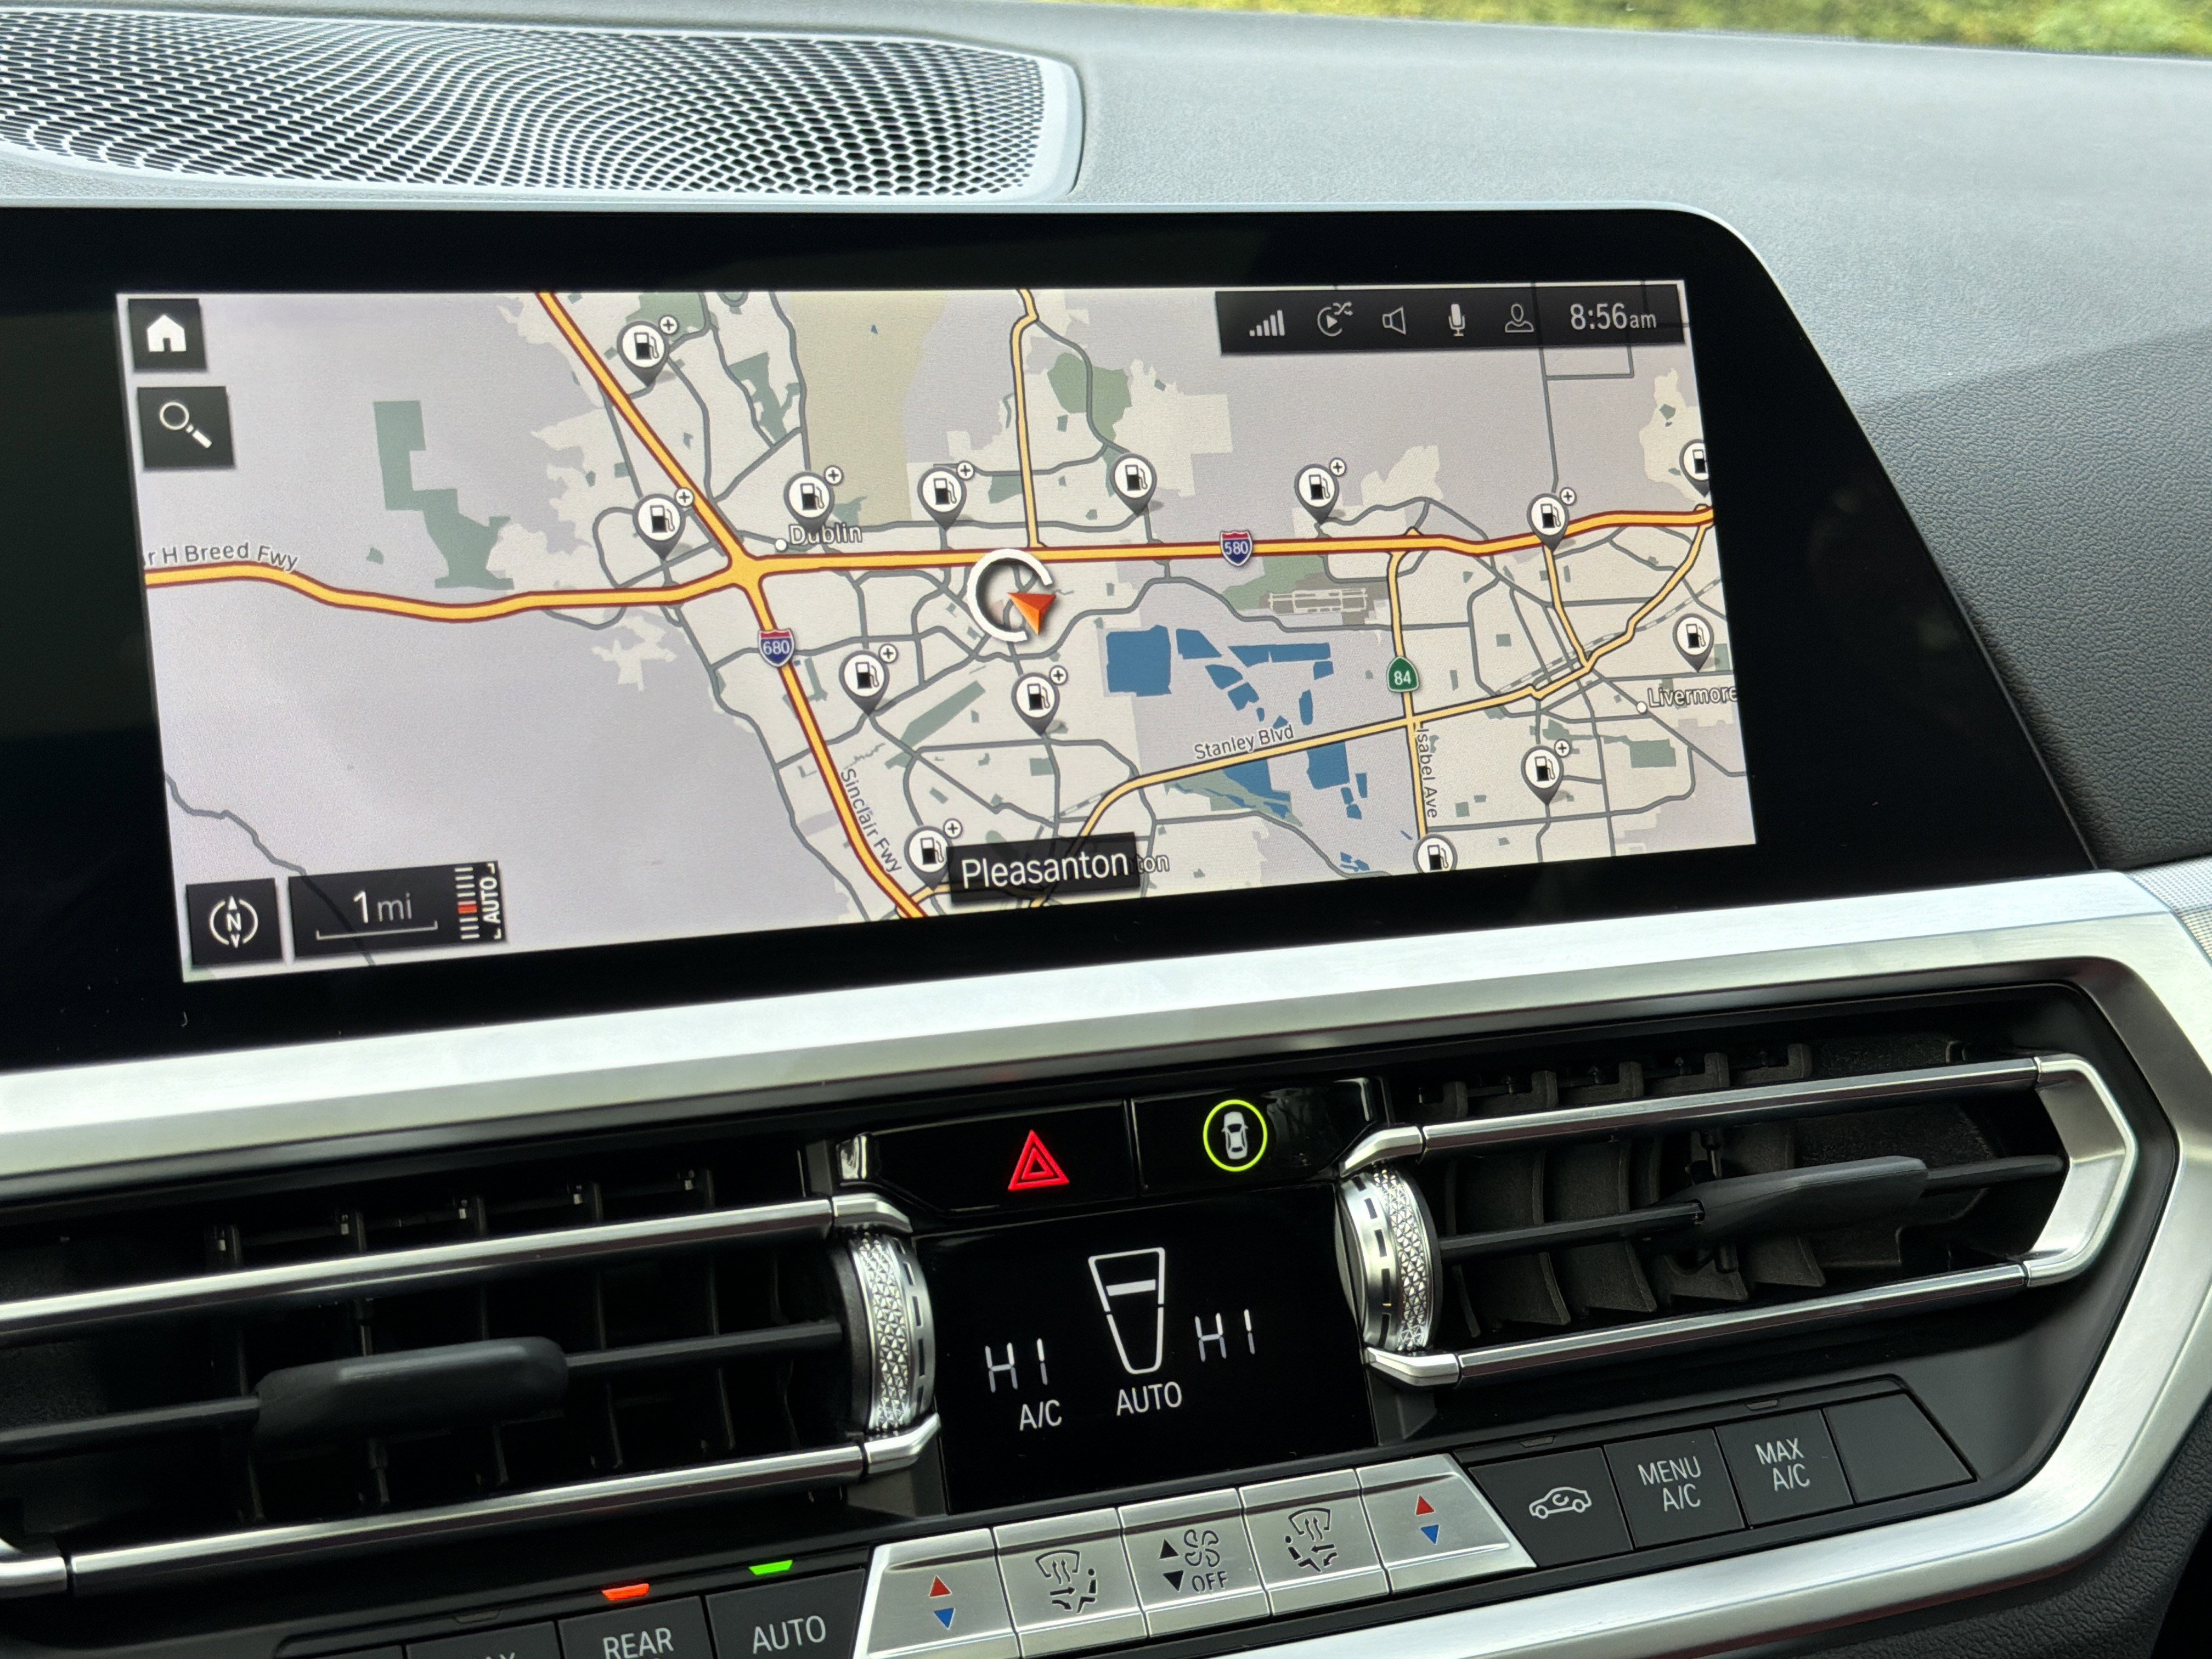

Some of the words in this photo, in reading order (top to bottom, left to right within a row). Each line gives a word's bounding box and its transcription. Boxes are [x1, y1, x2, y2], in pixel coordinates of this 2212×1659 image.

[1570, 303, 1657, 330] 8:56am
[788, 522, 863, 546] Dublin
[1224, 540, 1249, 556] 580
[162, 546, 178, 565] H
[184, 542, 249, 563] Breed
[257, 545, 298, 571] Fwy
[763, 640, 791, 656] 680
[1393, 670, 1412, 686] 84
[1647, 686, 1738, 708] Livermore
[1194, 735, 1254, 760] Stanley
[1258, 724, 1294, 746] Blvd
[1417, 729, 1436, 781] Isabel
[1424, 786, 1438, 819] Ave
[840, 768, 879, 837] Sinclair
[873, 837, 902, 872] Fwy
[961, 851, 1130, 889] Pleasanton
[353, 890, 369, 923] 1
[376, 892, 413, 922] mi
[479, 876, 501, 924] AUTO
[227, 911, 242, 930] N
[1194, 1308, 1256, 1362] HI
[985, 1338, 1048, 1393] HI
[1116, 1381, 1182, 1417] AUTO
[1019, 1400, 1063, 1431] A/C
[1755, 1437, 1805, 1465] MAX
[1637, 1455, 1701, 1486] MENU
[1772, 1463, 1810, 1492] A/C
[1662, 1483, 1701, 1512] A/C
[1191, 1571, 1228, 1593] OFF
[603, 1627, 674, 1659] REAR
[752, 1615, 826, 1655] AUTO
